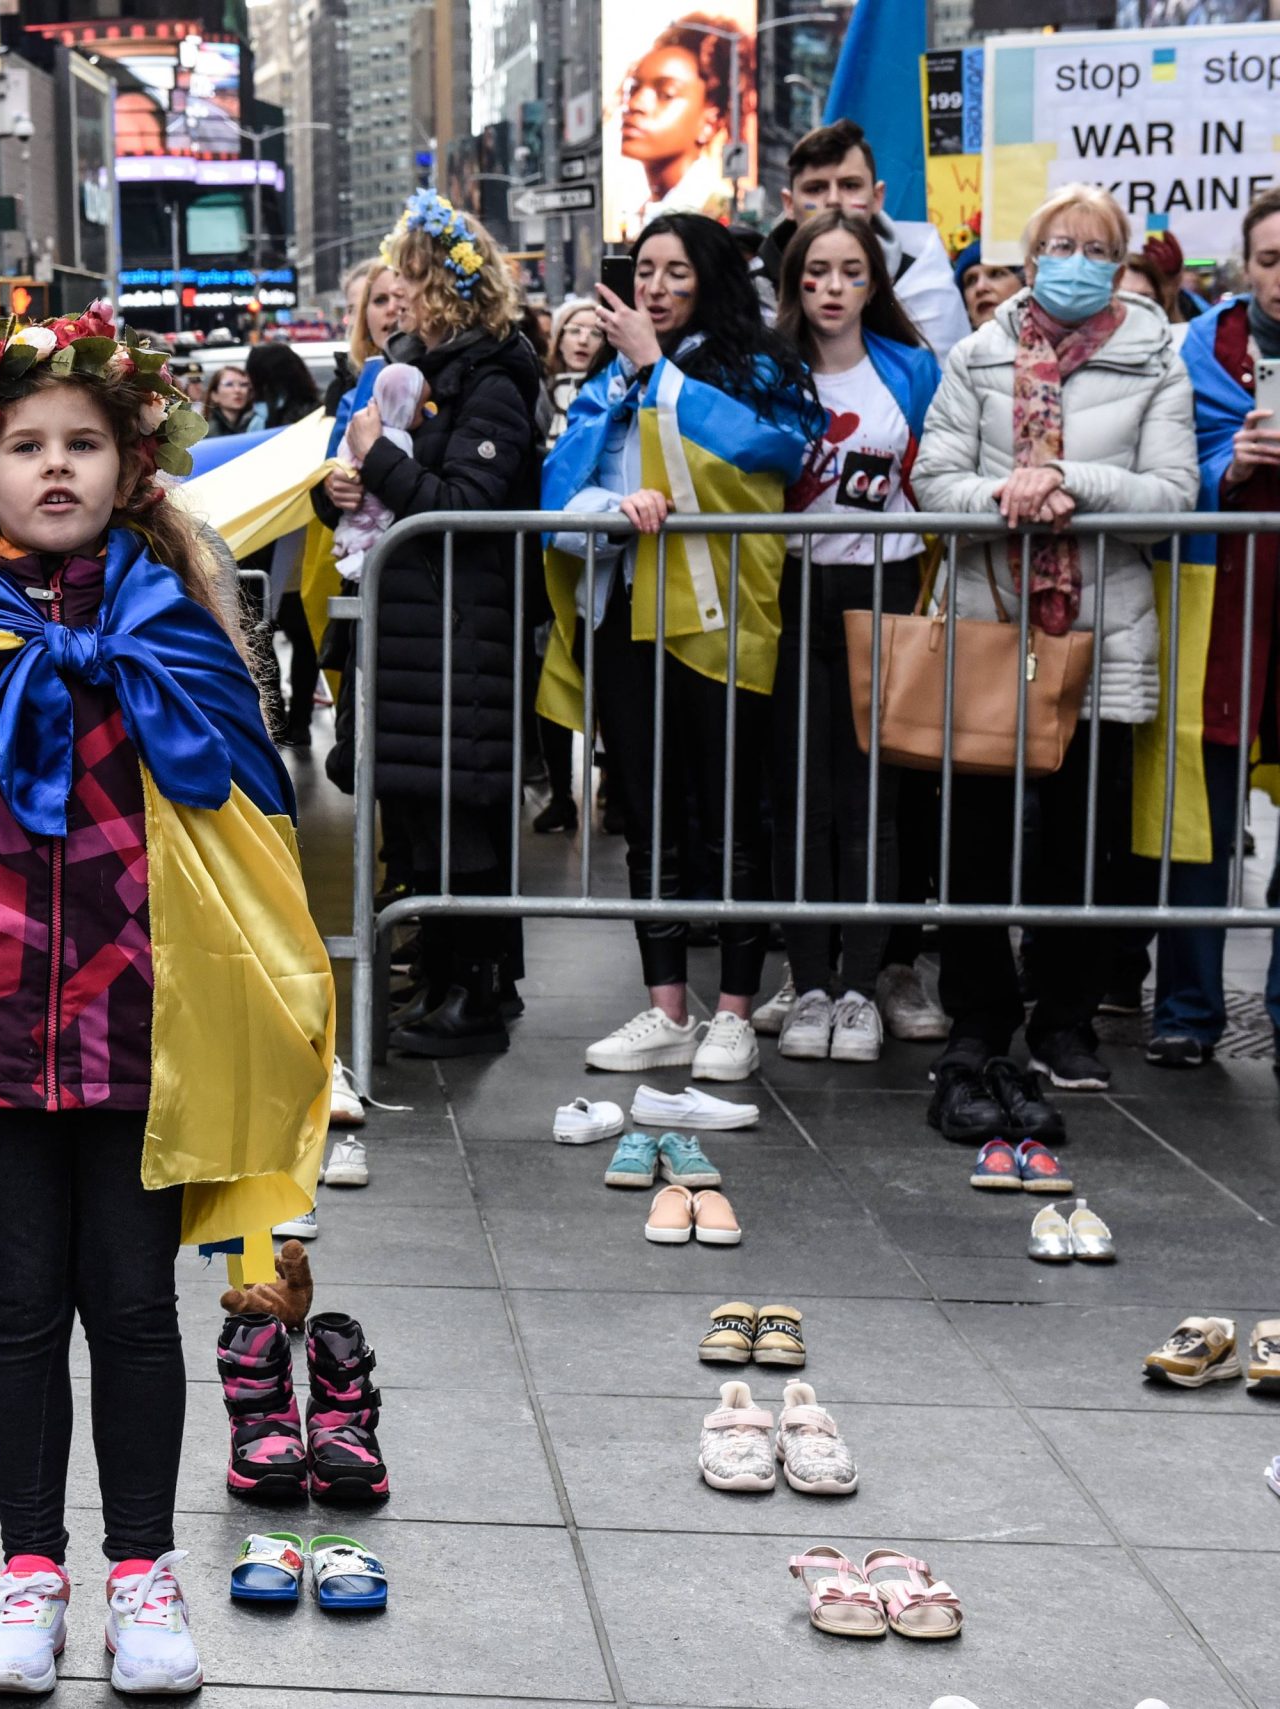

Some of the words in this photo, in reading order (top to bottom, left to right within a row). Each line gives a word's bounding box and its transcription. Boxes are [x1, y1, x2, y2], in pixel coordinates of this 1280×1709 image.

[1055, 57, 1141, 98] stop
[1072, 122, 1175, 158] WAR
[1201, 120, 1244, 155] IN
